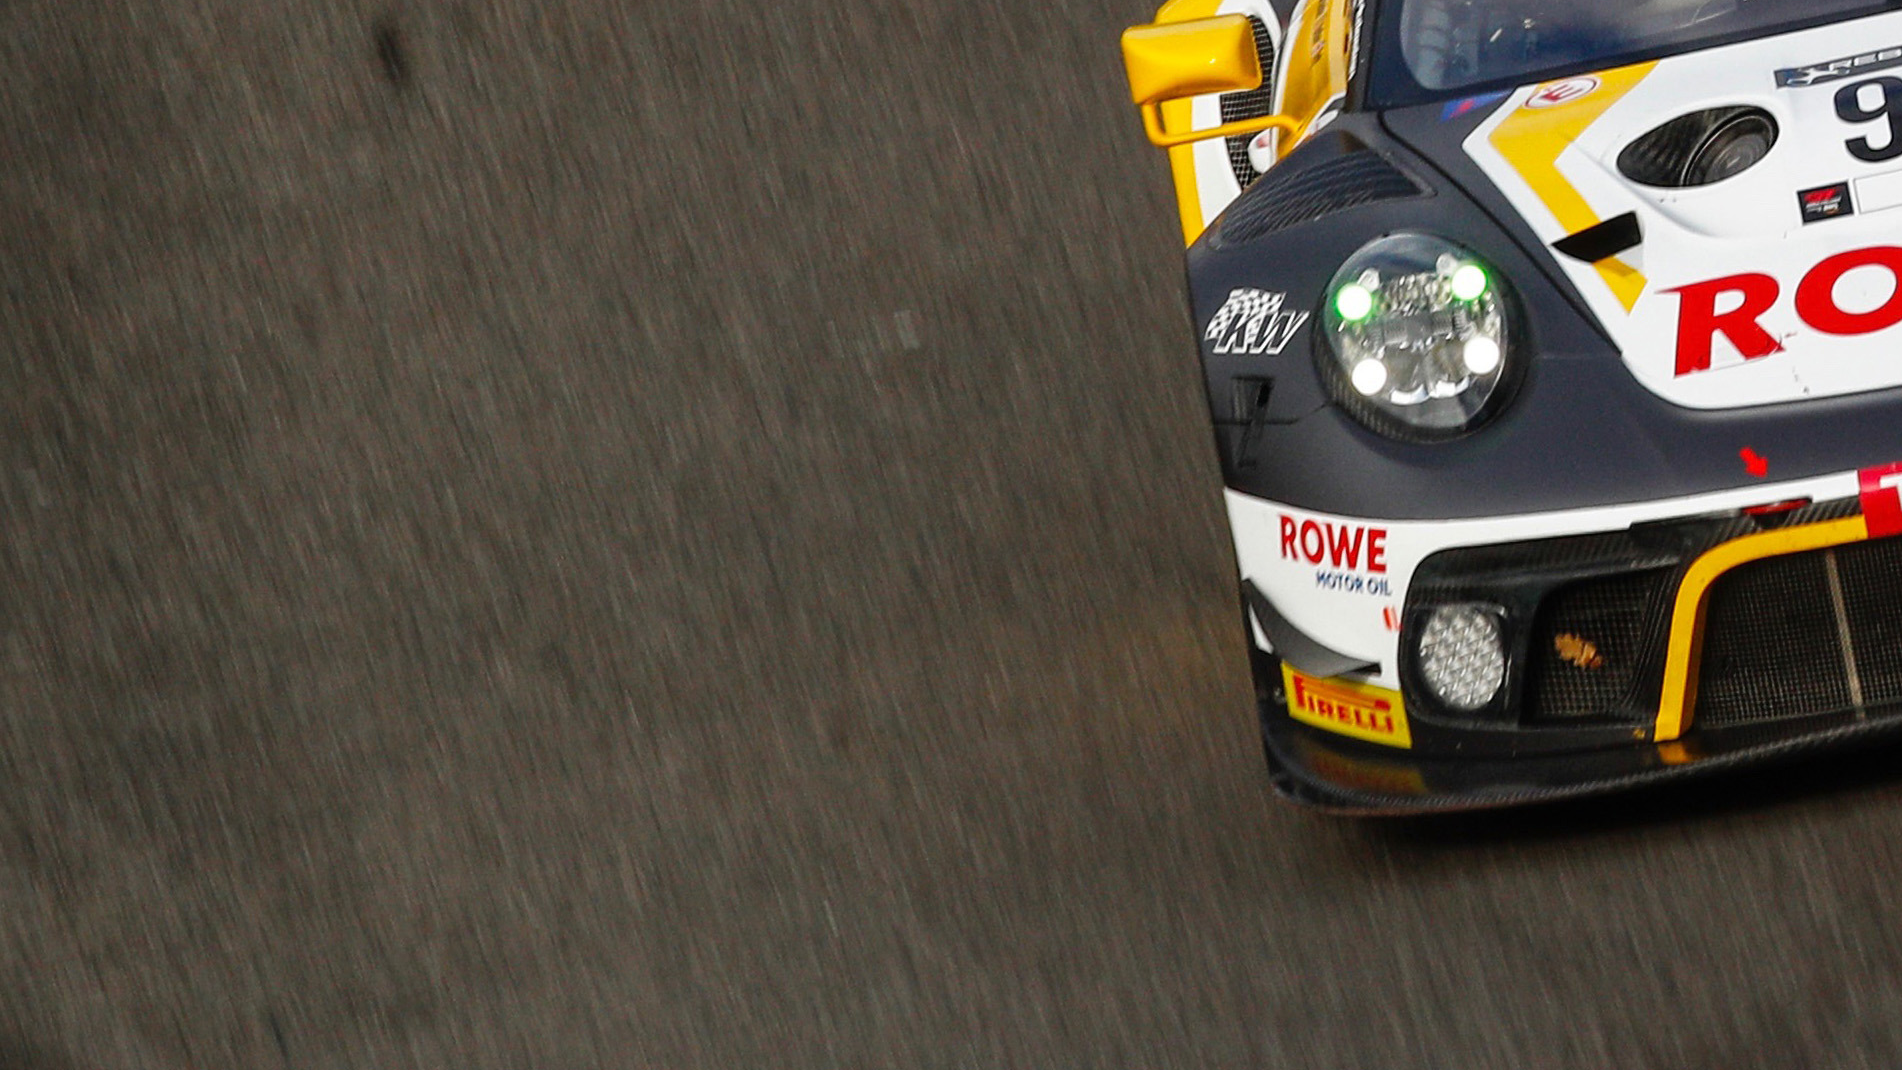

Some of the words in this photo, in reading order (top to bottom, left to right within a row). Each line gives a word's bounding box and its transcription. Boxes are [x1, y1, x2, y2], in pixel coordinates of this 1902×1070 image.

[1212, 305, 1310, 355] KW
[1278, 514, 1388, 574] ROWE
[1315, 571, 1364, 593] MOTOR
[1366, 577, 1392, 597] OIL
[1292, 673, 1394, 734] PIRELLI
